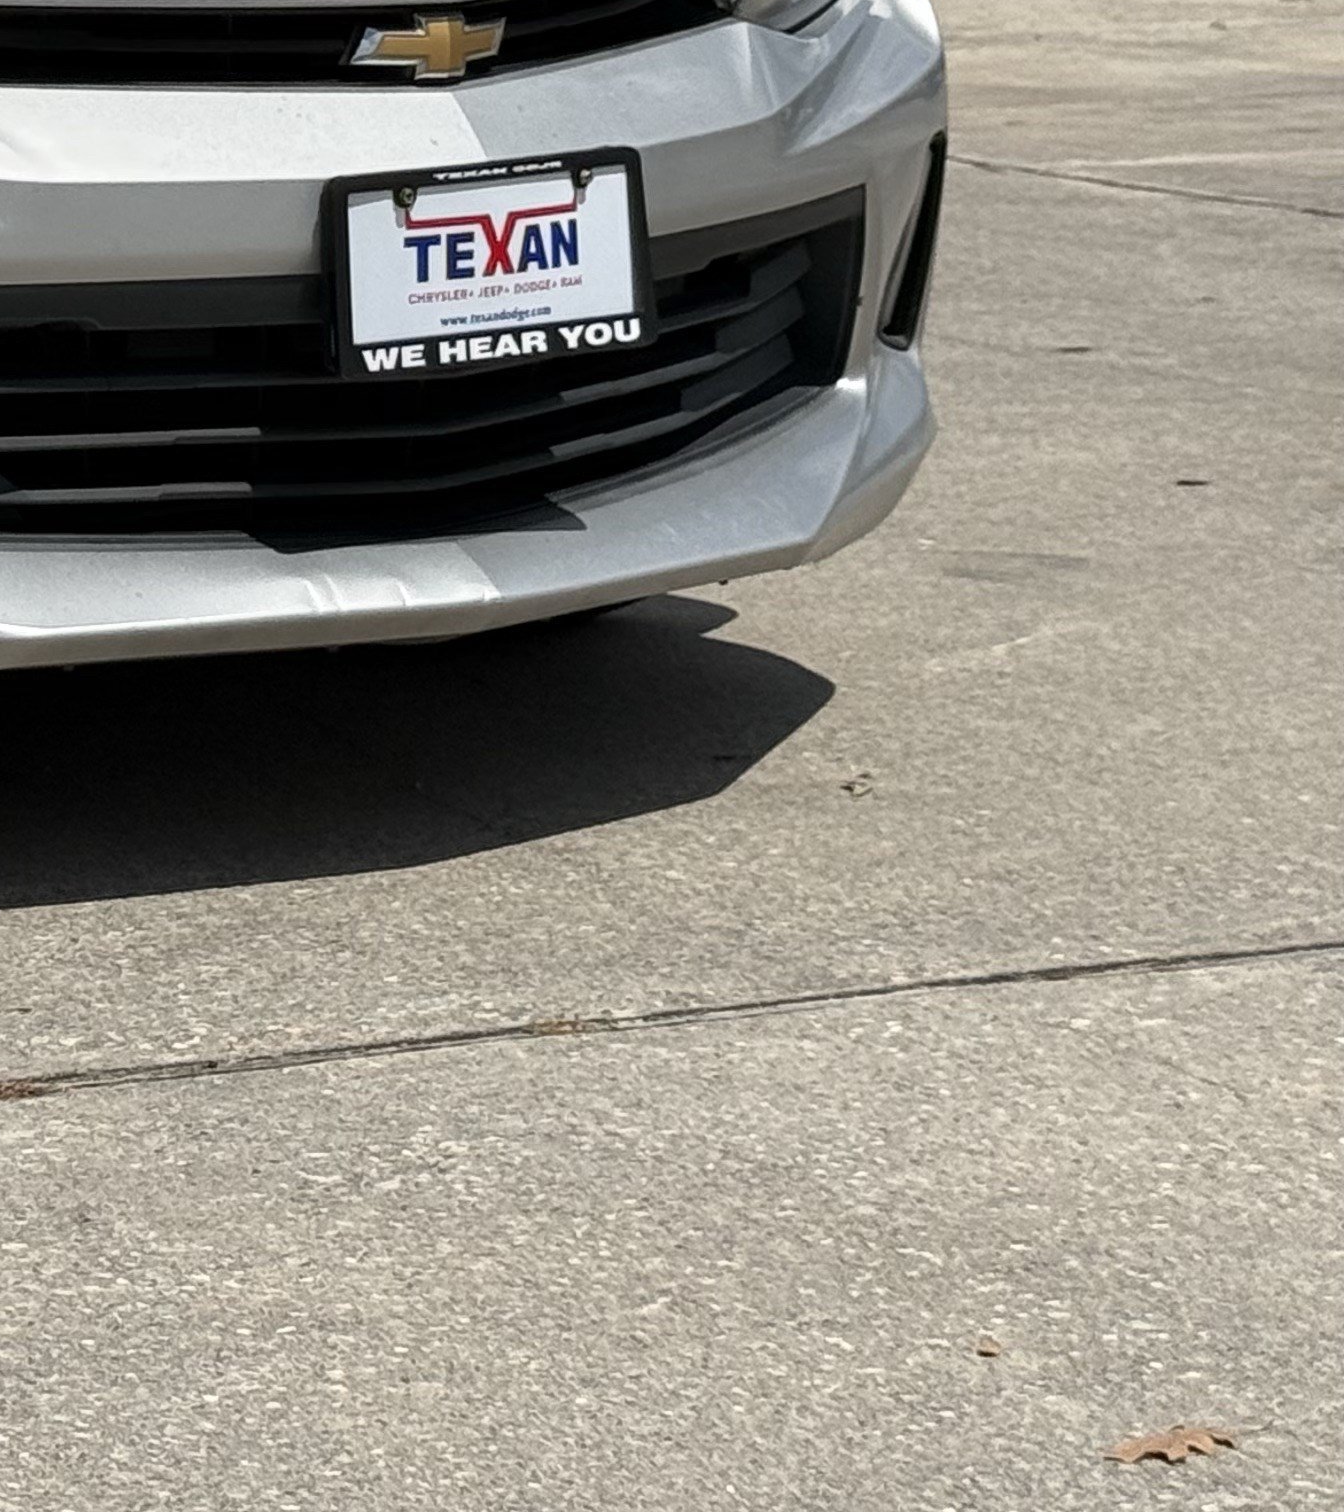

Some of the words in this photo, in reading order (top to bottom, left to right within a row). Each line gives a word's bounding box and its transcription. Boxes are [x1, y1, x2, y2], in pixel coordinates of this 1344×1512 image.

[433, 167, 507, 180] TEXAN
[403, 212, 579, 283] TEXAN
[408, 288, 468, 305] CHRYSLER
[477, 286, 505, 299] JEEP
[514, 279, 552, 295] DODGE
[561, 275, 583, 288] RAM
[361, 344, 427, 373] WE
[439, 329, 549, 364] HEAR
[557, 317, 642, 351] YOU
